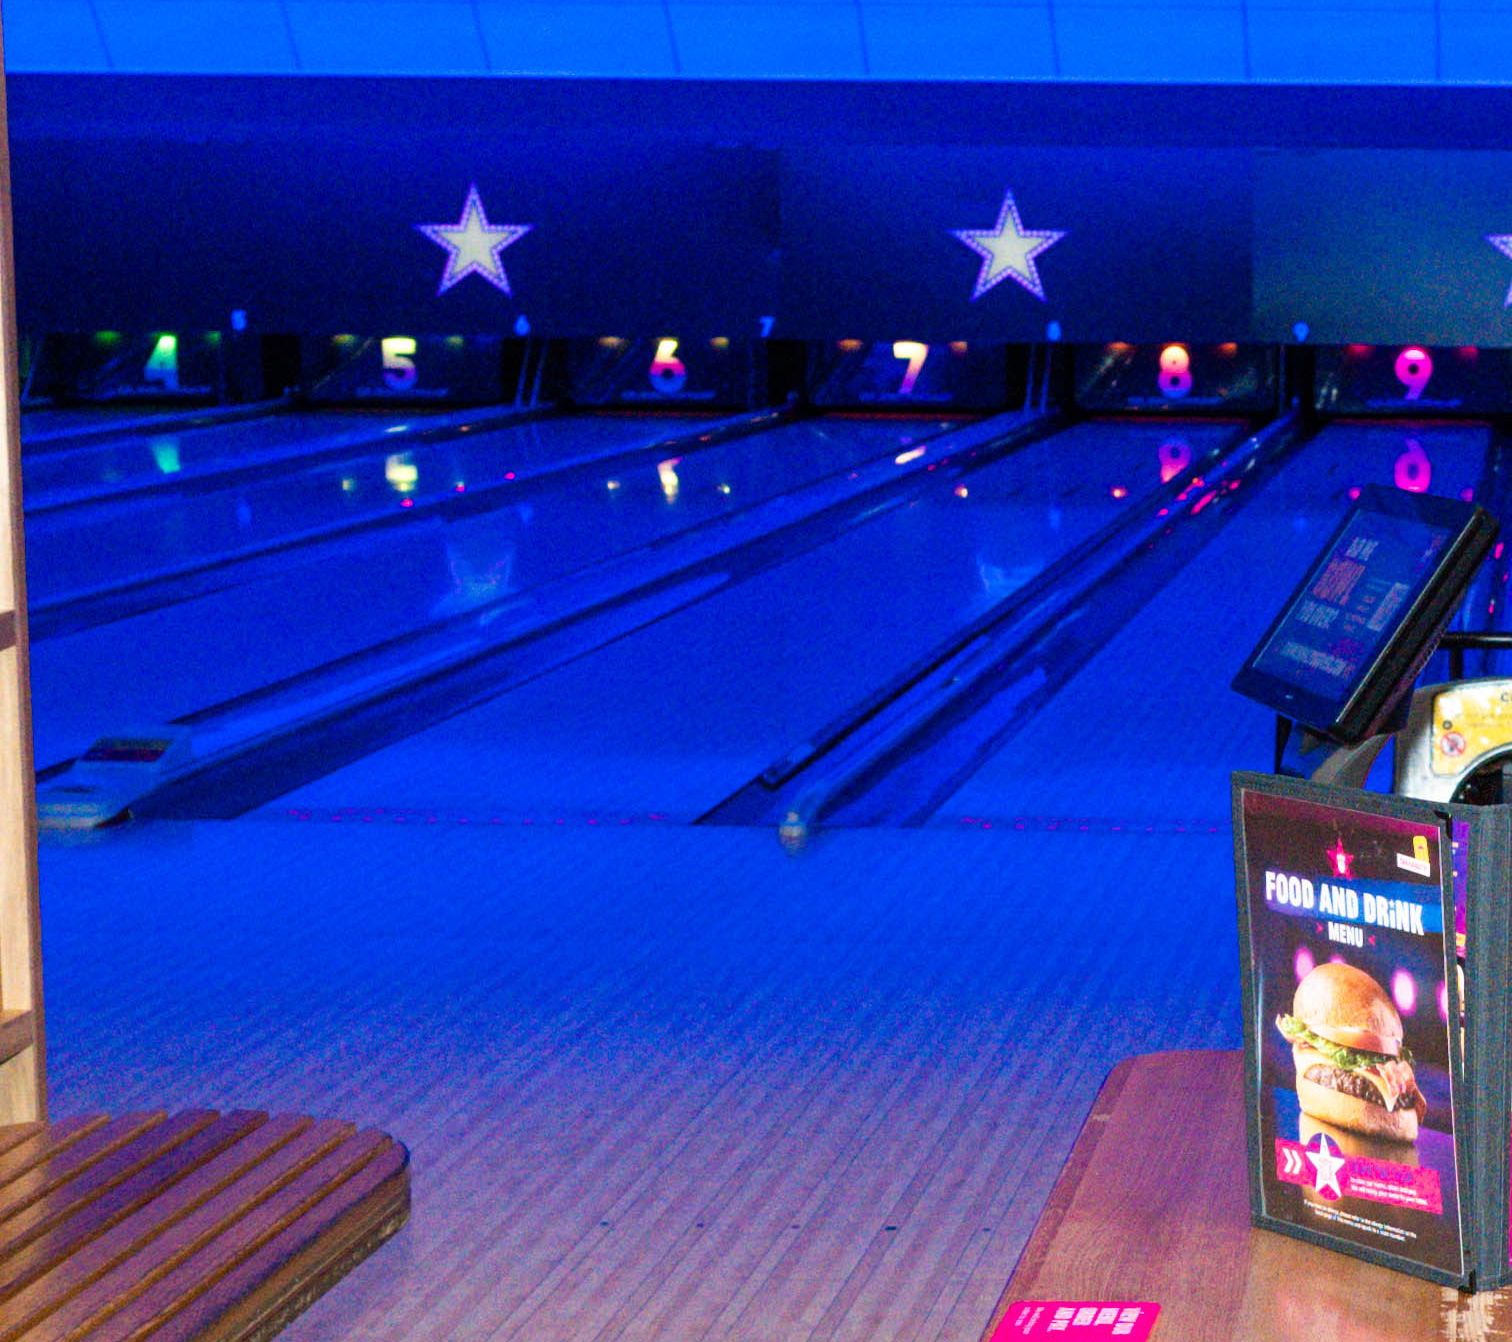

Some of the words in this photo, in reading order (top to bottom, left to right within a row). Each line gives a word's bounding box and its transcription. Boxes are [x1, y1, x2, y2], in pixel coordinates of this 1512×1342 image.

[759, 315, 776, 338] 7
[143, 334, 180, 391] 4
[381, 335, 418, 391] 5
[648, 338, 687, 394] 6
[893, 340, 930, 394] 7
[1157, 344, 1193, 398] 8
[1394, 348, 1434, 401] 9
[1265, 870, 1315, 909] FOOD
[1319, 884, 1360, 920] AND
[1328, 921, 1364, 949] MENU
